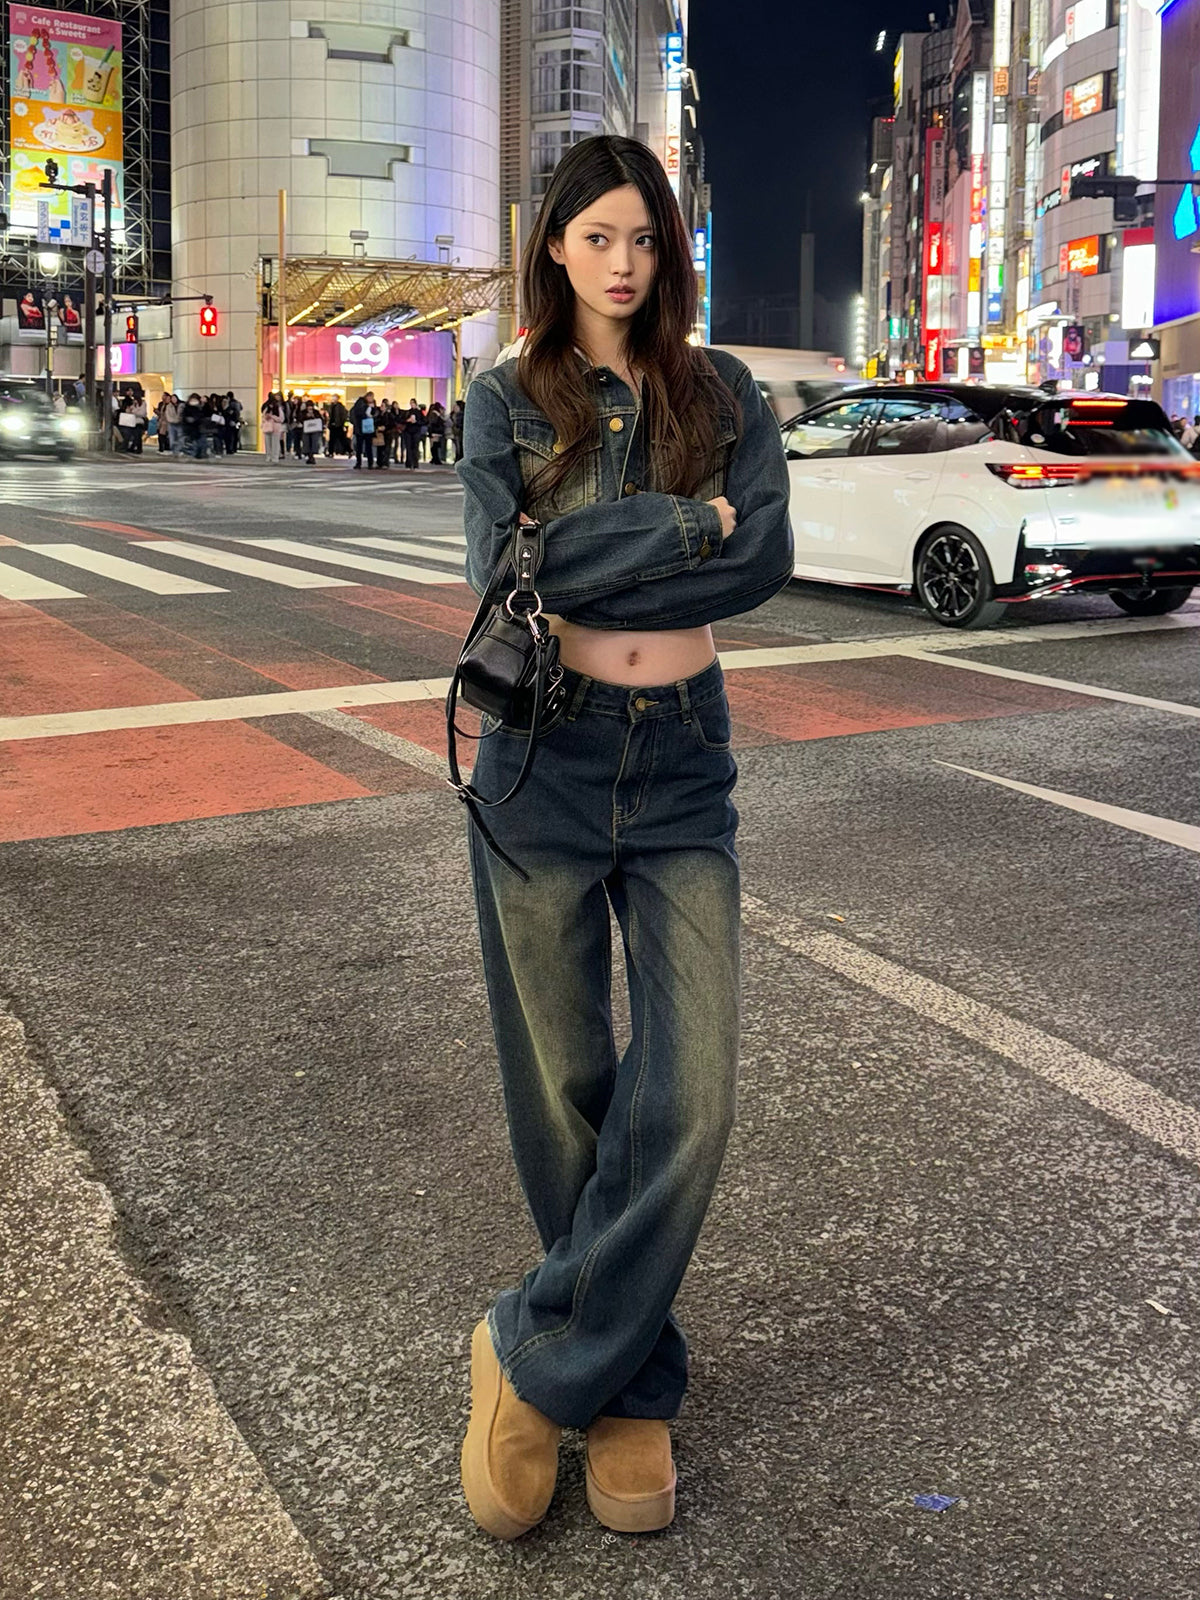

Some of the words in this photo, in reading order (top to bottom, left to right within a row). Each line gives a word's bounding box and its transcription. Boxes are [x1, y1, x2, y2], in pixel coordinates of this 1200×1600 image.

[31, 15, 51, 26] Cafe
[53, 19, 101, 34] Restaurant
[55, 27, 87, 39] Sweets
[667, 51, 682, 89] LABI
[667, 136, 679, 175] LABI
[336, 334, 389, 373] 109
